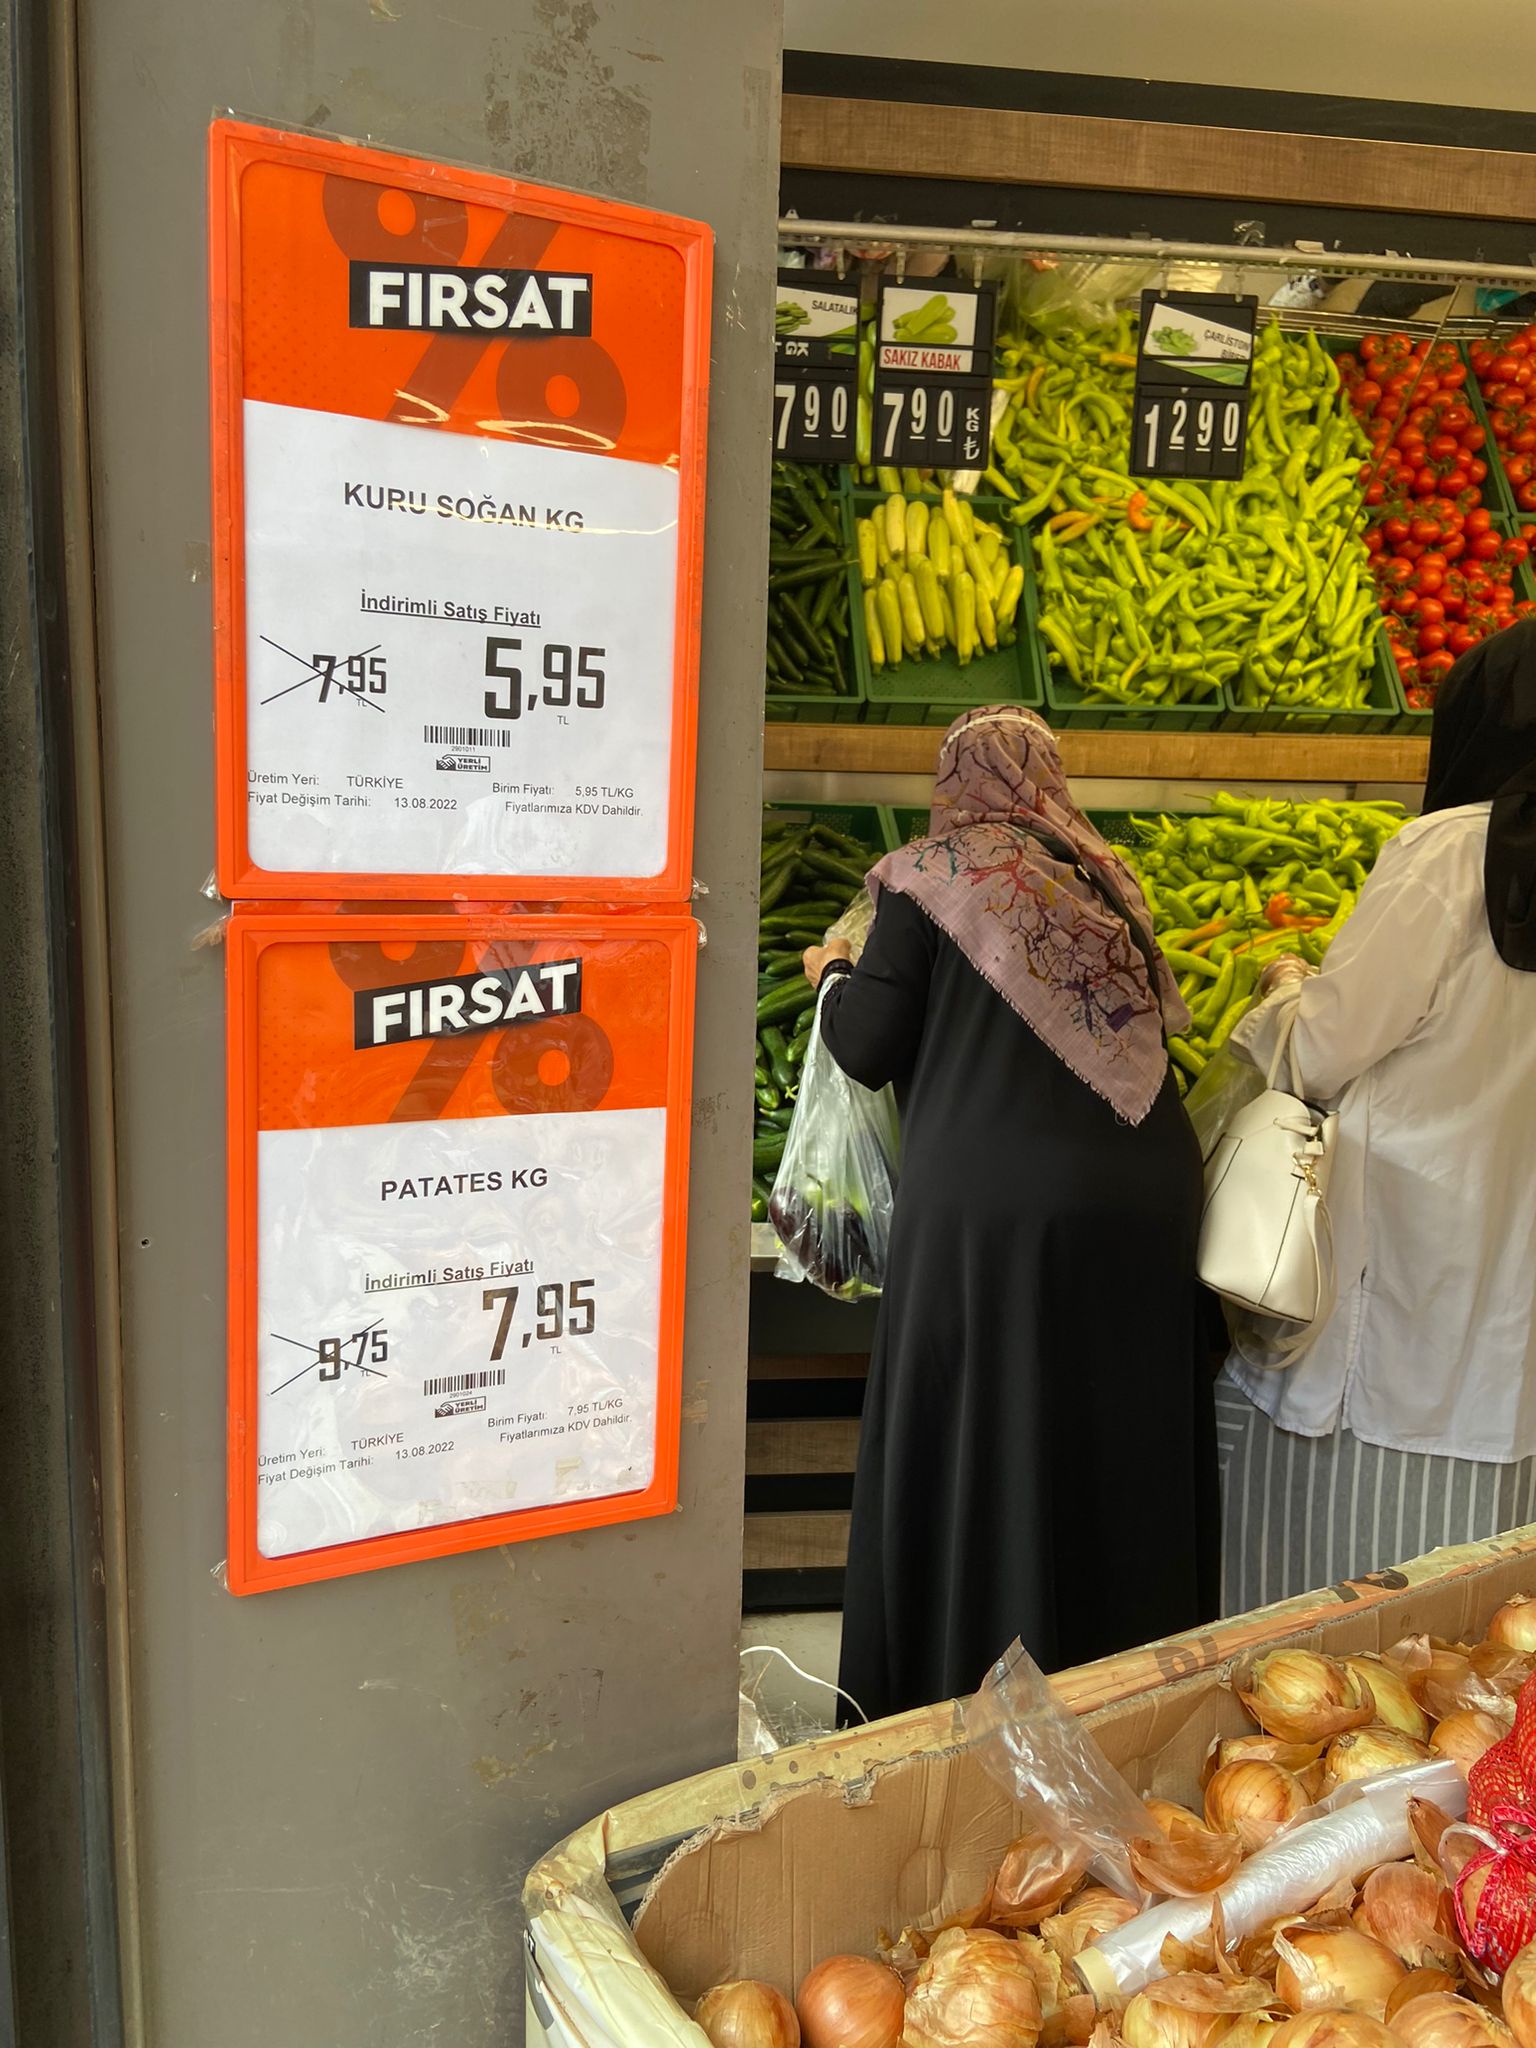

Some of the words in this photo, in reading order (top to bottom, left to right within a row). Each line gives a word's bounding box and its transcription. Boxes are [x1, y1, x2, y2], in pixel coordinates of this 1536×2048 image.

[368, 271, 589, 330] FIRSAT
[883, 348, 919, 367] SAKIZ
[920, 351, 961, 371] KABAK
[344, 482, 427, 515] KURU
[436, 493, 536, 529] SOĞAN
[546, 507, 585, 534] KG
[361, 588, 438, 616] İndirimli
[444, 601, 488, 624] Satış
[494, 605, 541, 627] Fiyatı
[312, 654, 387, 703] 7,95
[484, 636, 606, 720] 5,95
[557, 714, 570, 726] TL
[247, 769, 289, 785] Üretim
[291, 773, 320, 786] Yeri:
[346, 775, 404, 789] TÜRKİYE
[492, 782, 520, 794] Birim
[523, 783, 555, 797] Fiyatı:
[575, 785, 598, 798] 5,95
[601, 786, 634, 799] TL/KG
[247, 791, 278, 806] Fiyat
[281, 793, 331, 807] Değişim
[334, 794, 372, 808] Tarihi:
[393, 797, 458, 810] 13.08.2022
[505, 801, 572, 815] Fiyatlarımıza
[575, 803, 600, 815] KDV
[602, 804, 644, 817] Dahildir.
[372, 962, 579, 1045] FIRSAT
[381, 1171, 503, 1201] PATATES
[511, 1166, 549, 1188] KG
[365, 1269, 437, 1291] İndirimli
[443, 1265, 485, 1282] Satış
[490, 1258, 534, 1278] Fiyatı
[482, 1278, 596, 1361] 7,95
[318, 1329, 388, 1382] 9,75
[550, 1345, 562, 1355] TL
[487, 1415, 514, 1428] Birim
[517, 1411, 548, 1425] Fiyatı:
[568, 1403, 589, 1417] 7,95
[591, 1398, 623, 1411] TL/KG
[500, 1425, 565, 1443] Fiyatlarımıza
[567, 1420, 591, 1432] KDV
[592, 1413, 633, 1428] Dahildir.
[257, 1453, 297, 1467] Üretim
[299, 1447, 326, 1460] Yeri:
[351, 1432, 404, 1450] TÜRKİYE
[257, 1471, 287, 1485] Fiyat
[290, 1463, 336, 1480] Değişim
[339, 1456, 374, 1470] Tarihi:
[395, 1440, 455, 1460] 13.08.2022
